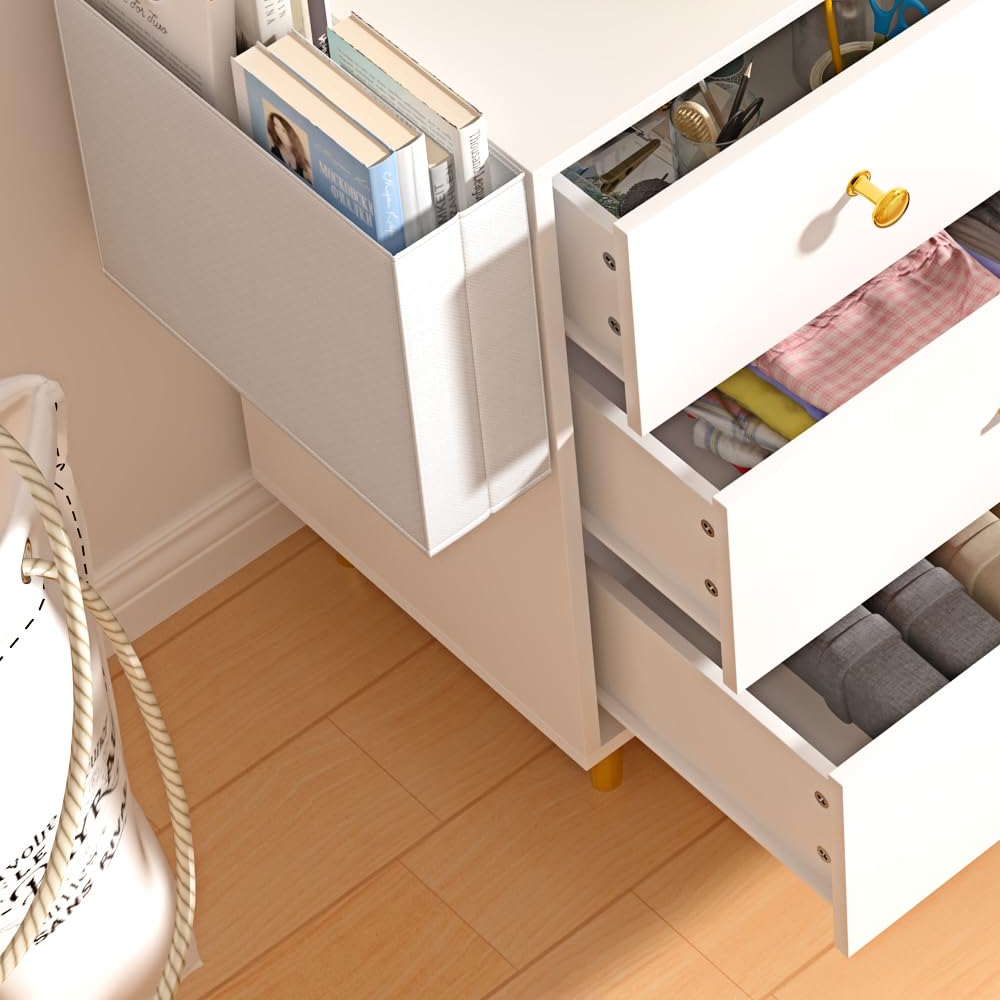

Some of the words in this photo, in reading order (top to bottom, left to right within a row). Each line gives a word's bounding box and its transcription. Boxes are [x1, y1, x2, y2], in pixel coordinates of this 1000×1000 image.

[147, 9, 168, 35] Two
[469, 128, 485, 174] Thousand
[33, 879, 94, 946] SANS
